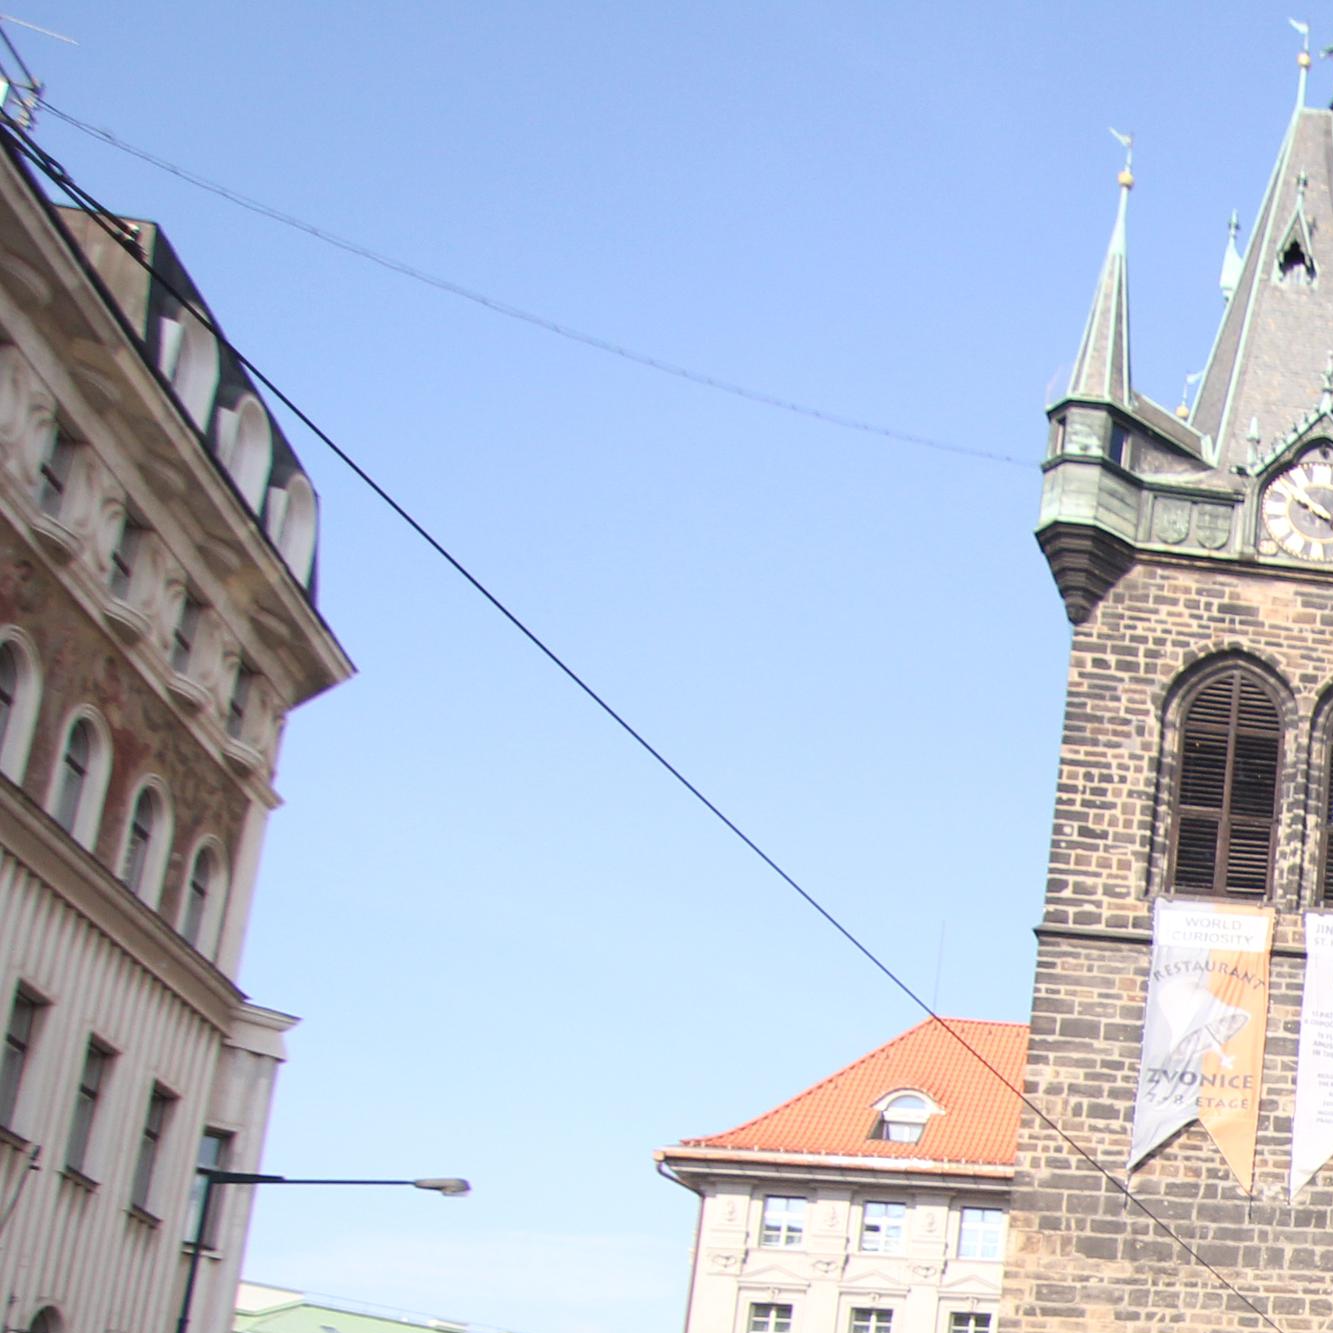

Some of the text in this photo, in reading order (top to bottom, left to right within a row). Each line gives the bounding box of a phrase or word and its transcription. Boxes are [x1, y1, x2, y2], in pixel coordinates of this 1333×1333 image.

[1184, 917, 1242, 930] WORLD
[1171, 931, 1254, 945] CURIOSITY
[1153, 959, 1265, 990] RESTAURANT
[1147, 1068, 1254, 1089] ZVONICE
